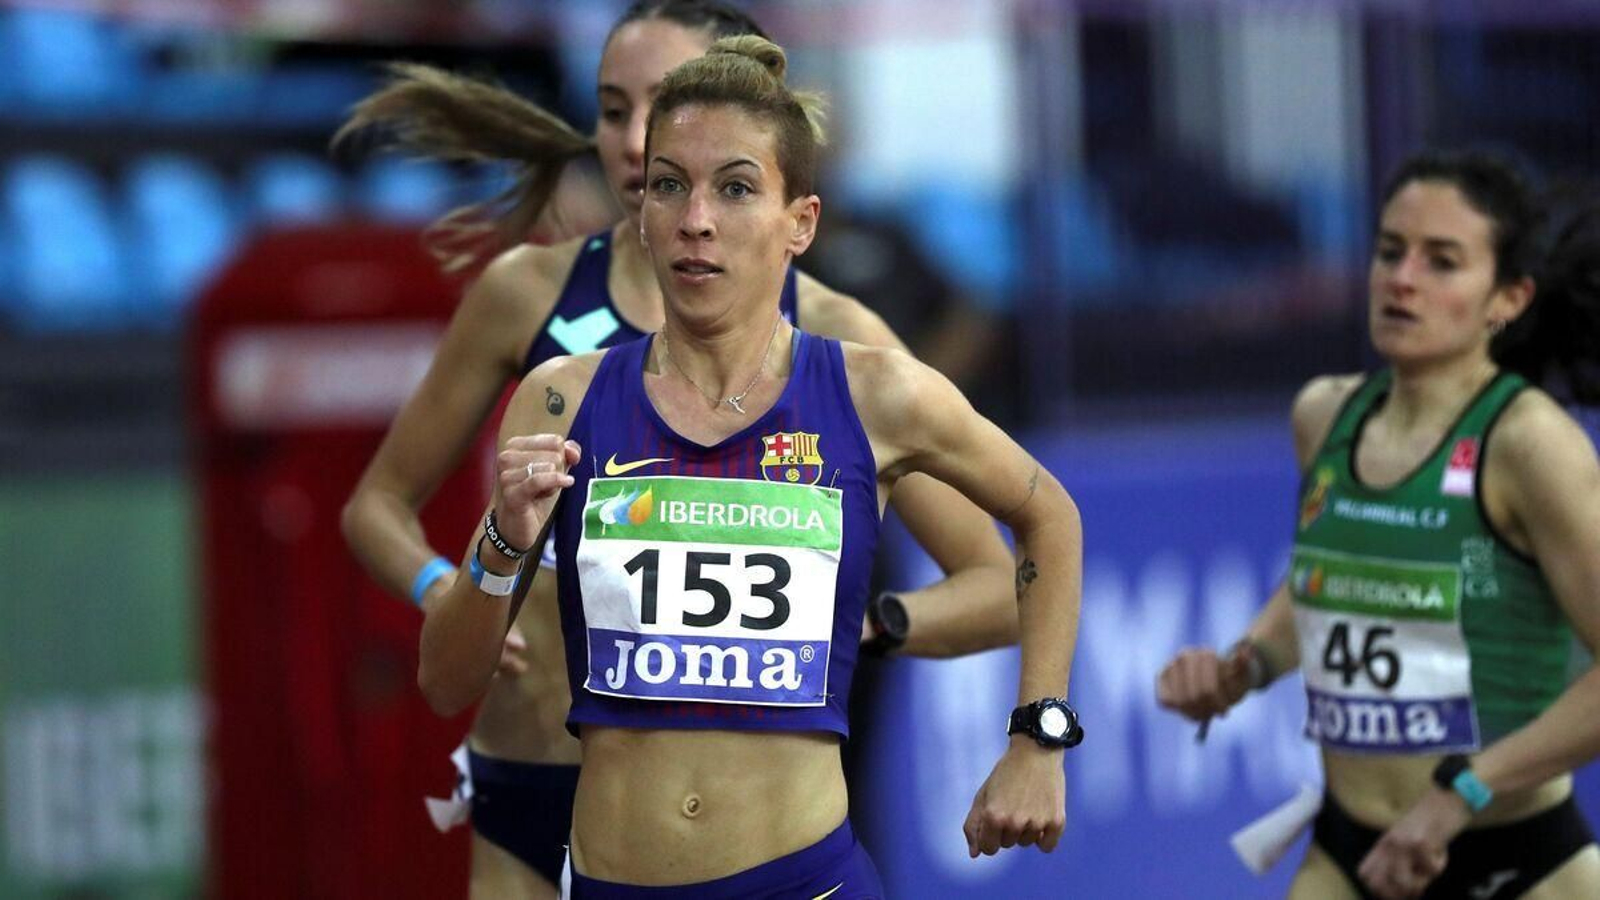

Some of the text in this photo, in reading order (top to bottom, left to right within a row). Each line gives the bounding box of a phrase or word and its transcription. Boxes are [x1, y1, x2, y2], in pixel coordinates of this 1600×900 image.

[780, 456, 804, 464] FCB
[660, 500, 825, 531] IBERDROLA
[487, 526, 498, 541] DO
[495, 540, 506, 549] IT
[624, 549, 791, 630] 153
[1323, 621, 1400, 690] 46
